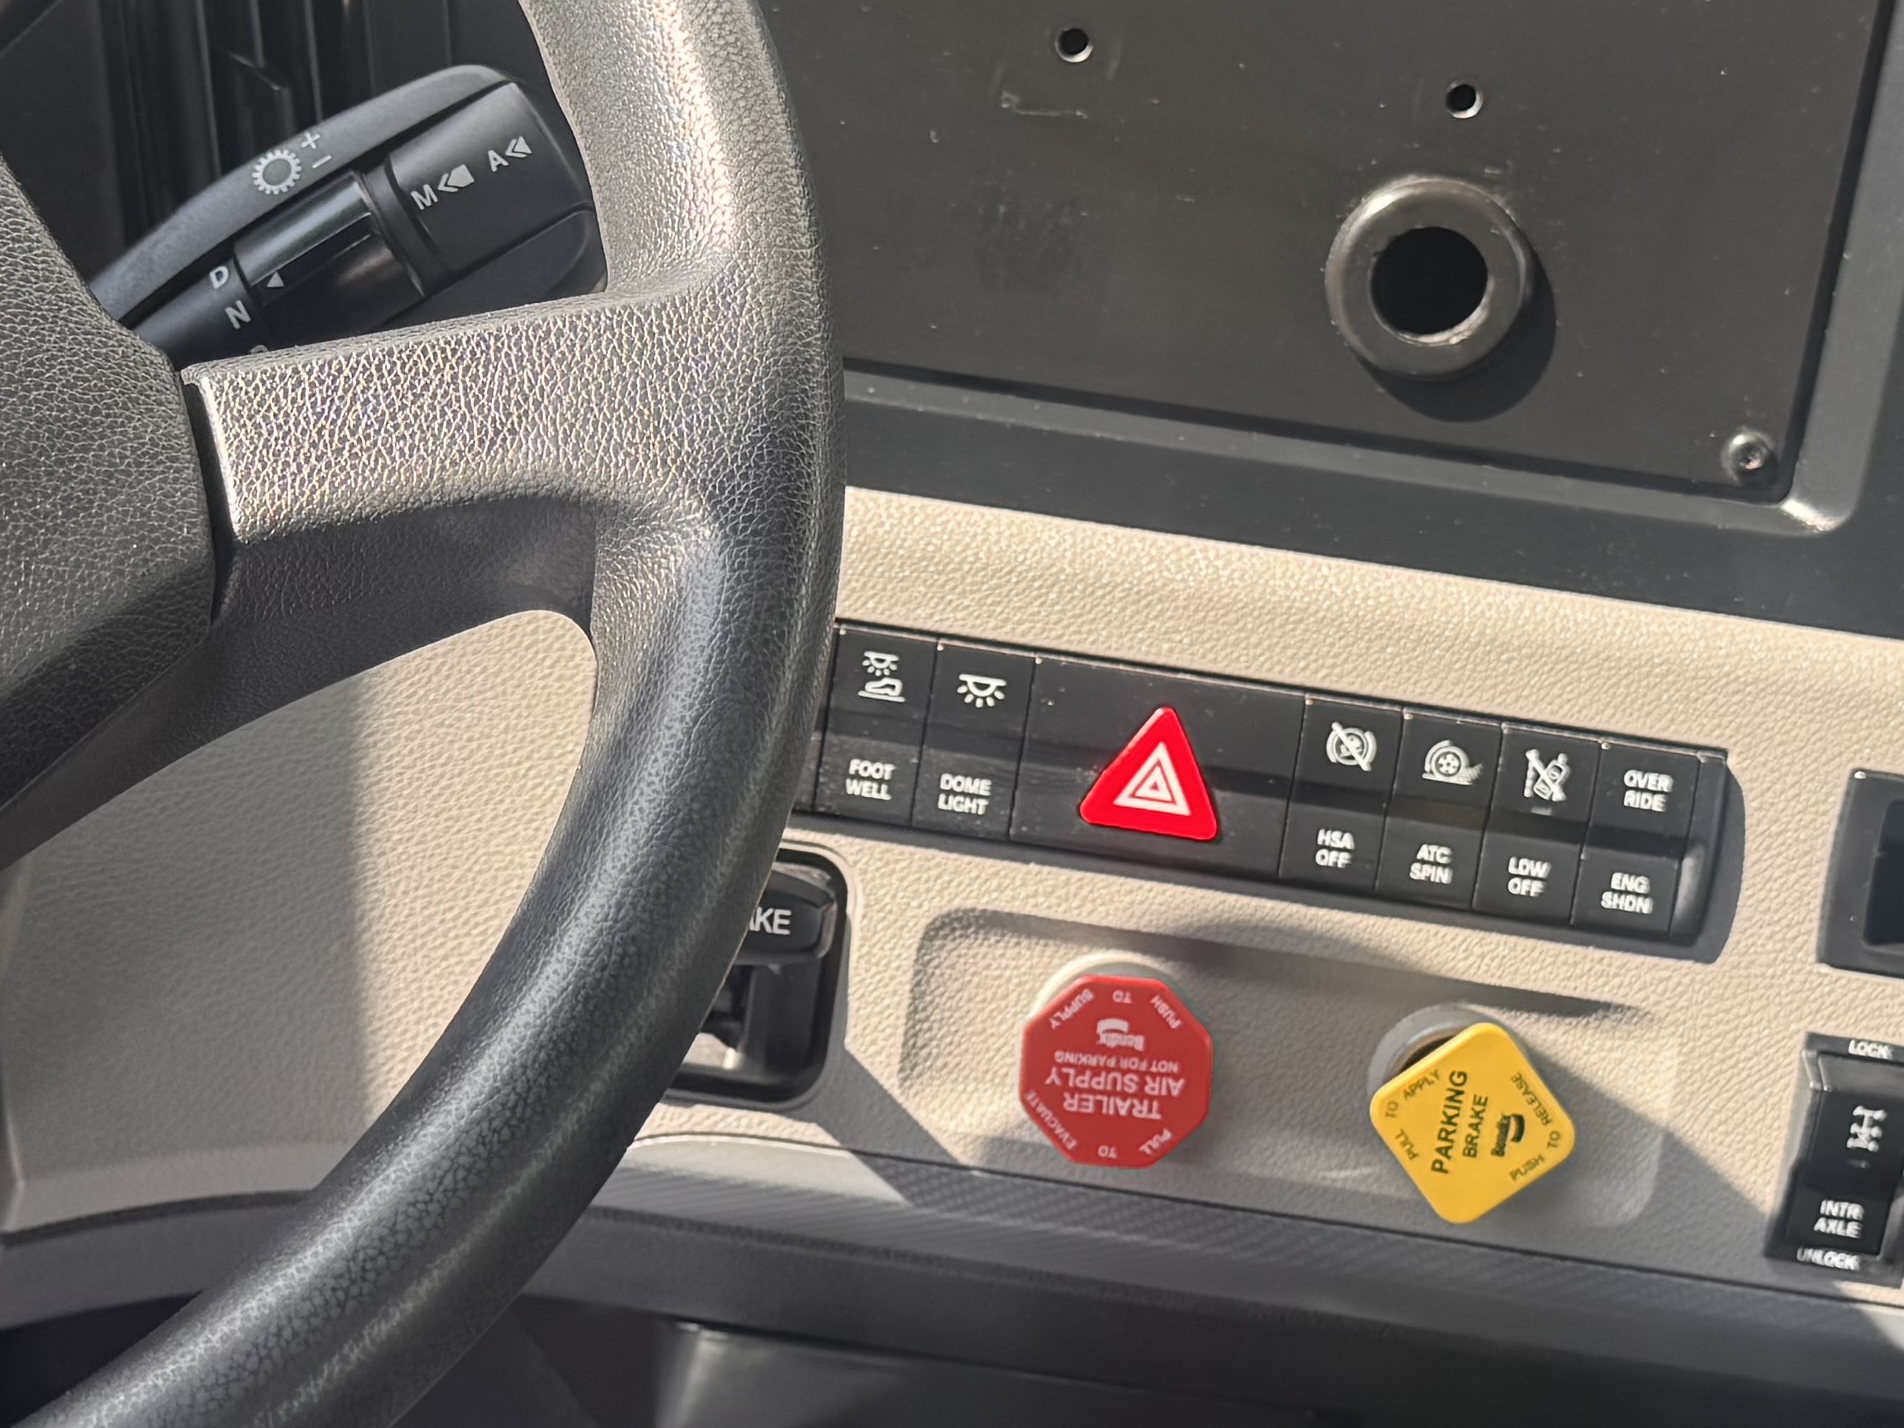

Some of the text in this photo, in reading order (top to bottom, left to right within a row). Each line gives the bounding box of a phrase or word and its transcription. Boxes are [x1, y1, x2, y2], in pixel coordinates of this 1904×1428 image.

[487, 149, 509, 172] A
[411, 183, 439, 211] M
[209, 265, 230, 290] D
[224, 299, 251, 330] N
[848, 758, 896, 781] FOOT
[846, 778, 892, 801] WELL
[940, 773, 992, 796] DOME
[1624, 770, 1674, 793] OVER
[938, 793, 990, 816] LIGHT
[1623, 790, 1668, 813] RIDE
[1317, 828, 1356, 850] HSA
[1315, 847, 1353, 869] OFF
[1415, 843, 1454, 865] ATC
[1409, 862, 1454, 885] SPIN
[1610, 872, 1651, 895] ENG
[1507, 876, 1548, 898] OFF
[1600, 890, 1654, 915] SHDN
[1048, 988, 1183, 1030] PUSH TO SUPPLY
[1848, 1038, 1893, 1060] LOCK
[1054, 1050, 1179, 1073] NOT FOR PARKING
[1045, 1065, 1185, 1098] AIR SUPPLY
[1062, 1091, 1162, 1121] TRAILER
[1384, 1068, 1441, 1162] PULL TO APPLY
[1023, 1088, 1173, 1159] PULL TO EVACUATE
[1430, 1070, 1469, 1175] PARKING
[1462, 1093, 1490, 1159] BRAKE
[1509, 1071, 1562, 1182] PUSH TO RELEASE
[1819, 1199, 1865, 1221] INTR
[1814, 1217, 1863, 1239] AXLE
[1796, 1247, 1861, 1271] UNLOCK
